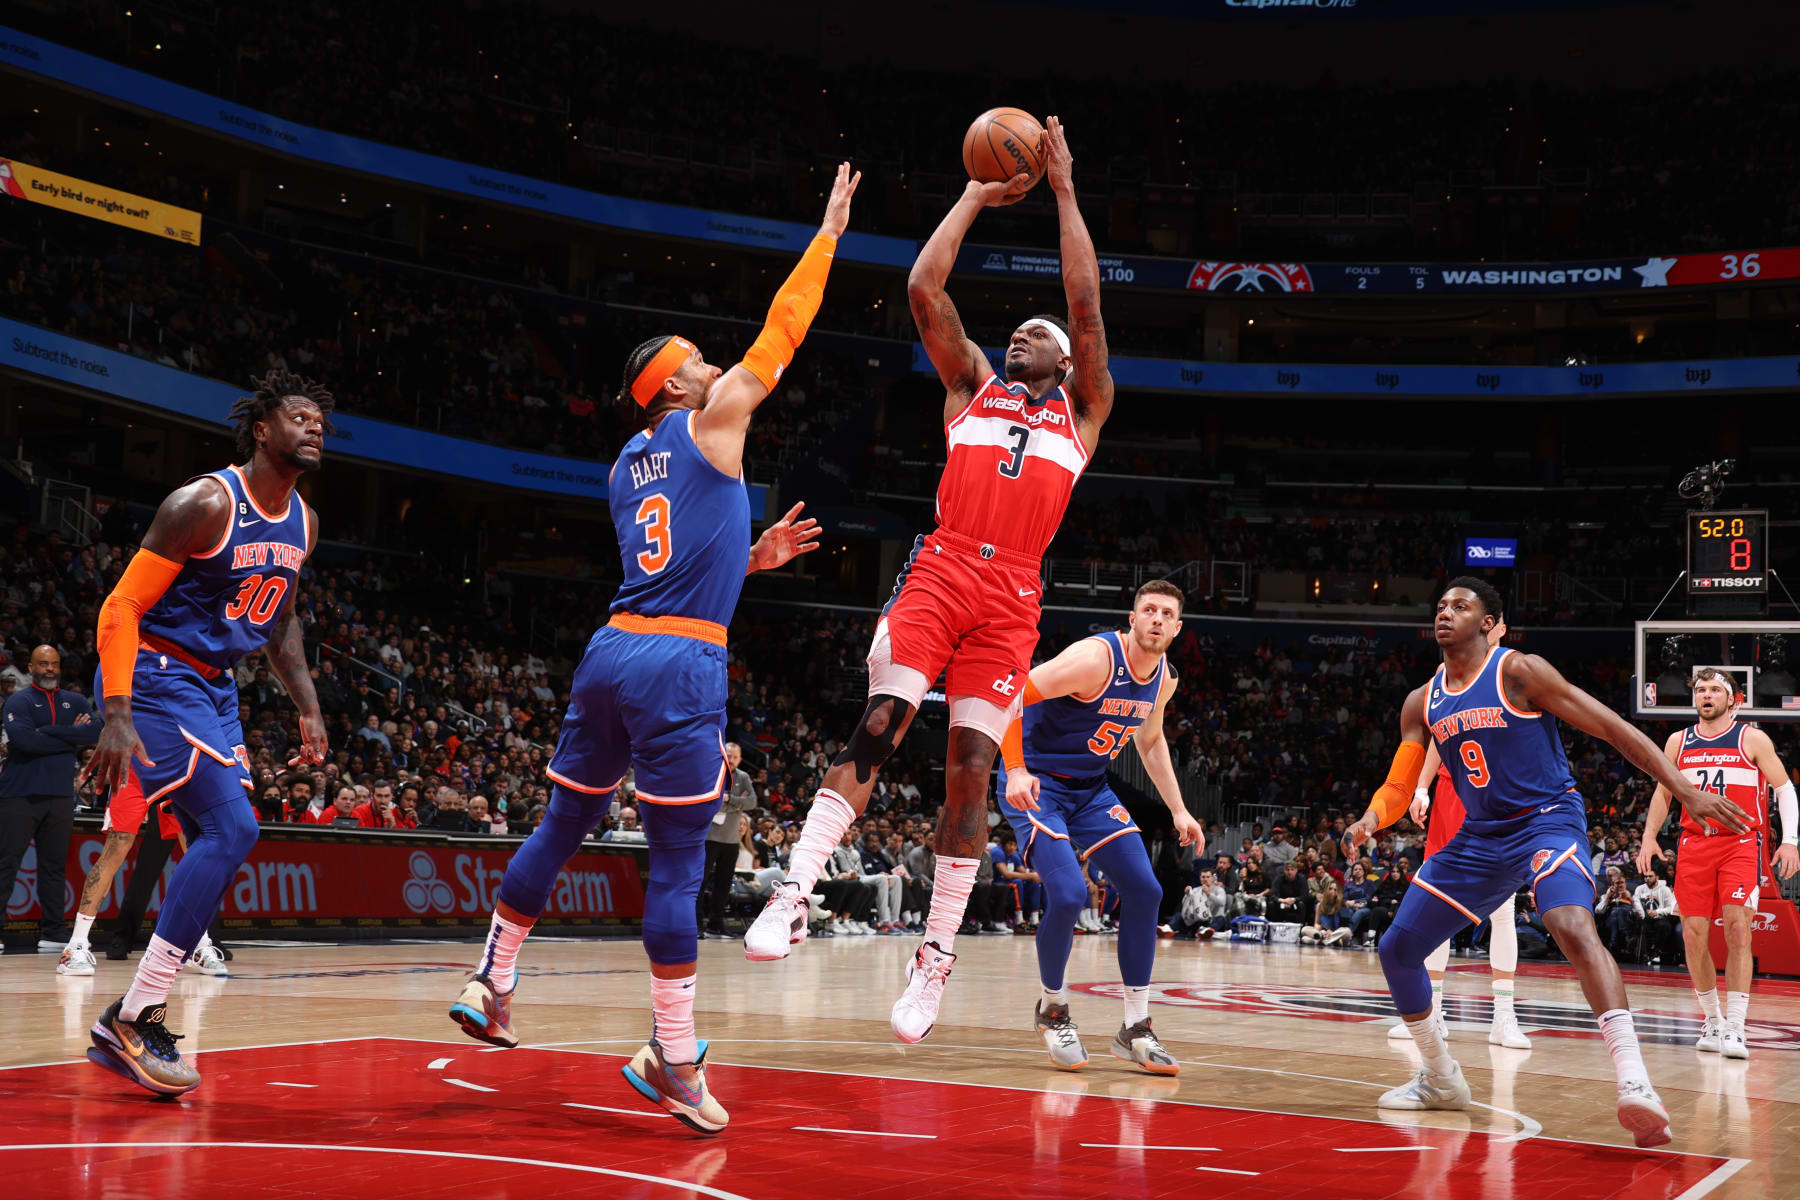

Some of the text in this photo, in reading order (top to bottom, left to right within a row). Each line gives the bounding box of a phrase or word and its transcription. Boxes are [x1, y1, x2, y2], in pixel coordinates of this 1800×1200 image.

[31, 179, 150, 220] Early bird or night owl?
[1011, 256, 1060, 265] FOUNDATION
[1098, 259, 1123, 267] CKPOT
[1345, 267, 1429, 275] FOULS TOL
[1719, 252, 1761, 280] 36
[1101, 268, 1135, 283] ,100
[1358, 278, 1425, 291] 2 5
[1441, 266, 1622, 285] WASHINGTON
[12, 337, 110, 378] Subtract the noise.
[982, 397, 1066, 426] washngton
[998, 425, 1030, 479] 3
[511, 462, 554, 480] Subtract
[557, 470, 573, 482] the
[629, 451, 672, 490] HART
[239, 502, 248, 515] 6
[635, 492, 672, 576] 3
[1699, 518, 1744, 538] 52.0
[232, 541, 270, 570] NEW
[1730, 538, 1752, 571] 8
[1711, 577, 1763, 587] TISSOT
[225, 574, 288, 625] 30
[1117, 666, 1125, 677] 6
[992, 673, 1016, 697] dc
[1433, 688, 1440, 699] 6
[1097, 698, 1132, 717] NEW
[1430, 707, 1508, 745] NEW YORK
[1459, 740, 1491, 789] 9
[1683, 752, 1741, 765] washington
[1696, 769, 1727, 798] 24
[220, 860, 318, 914] arm
[455, 853, 614, 913] Sta arm
